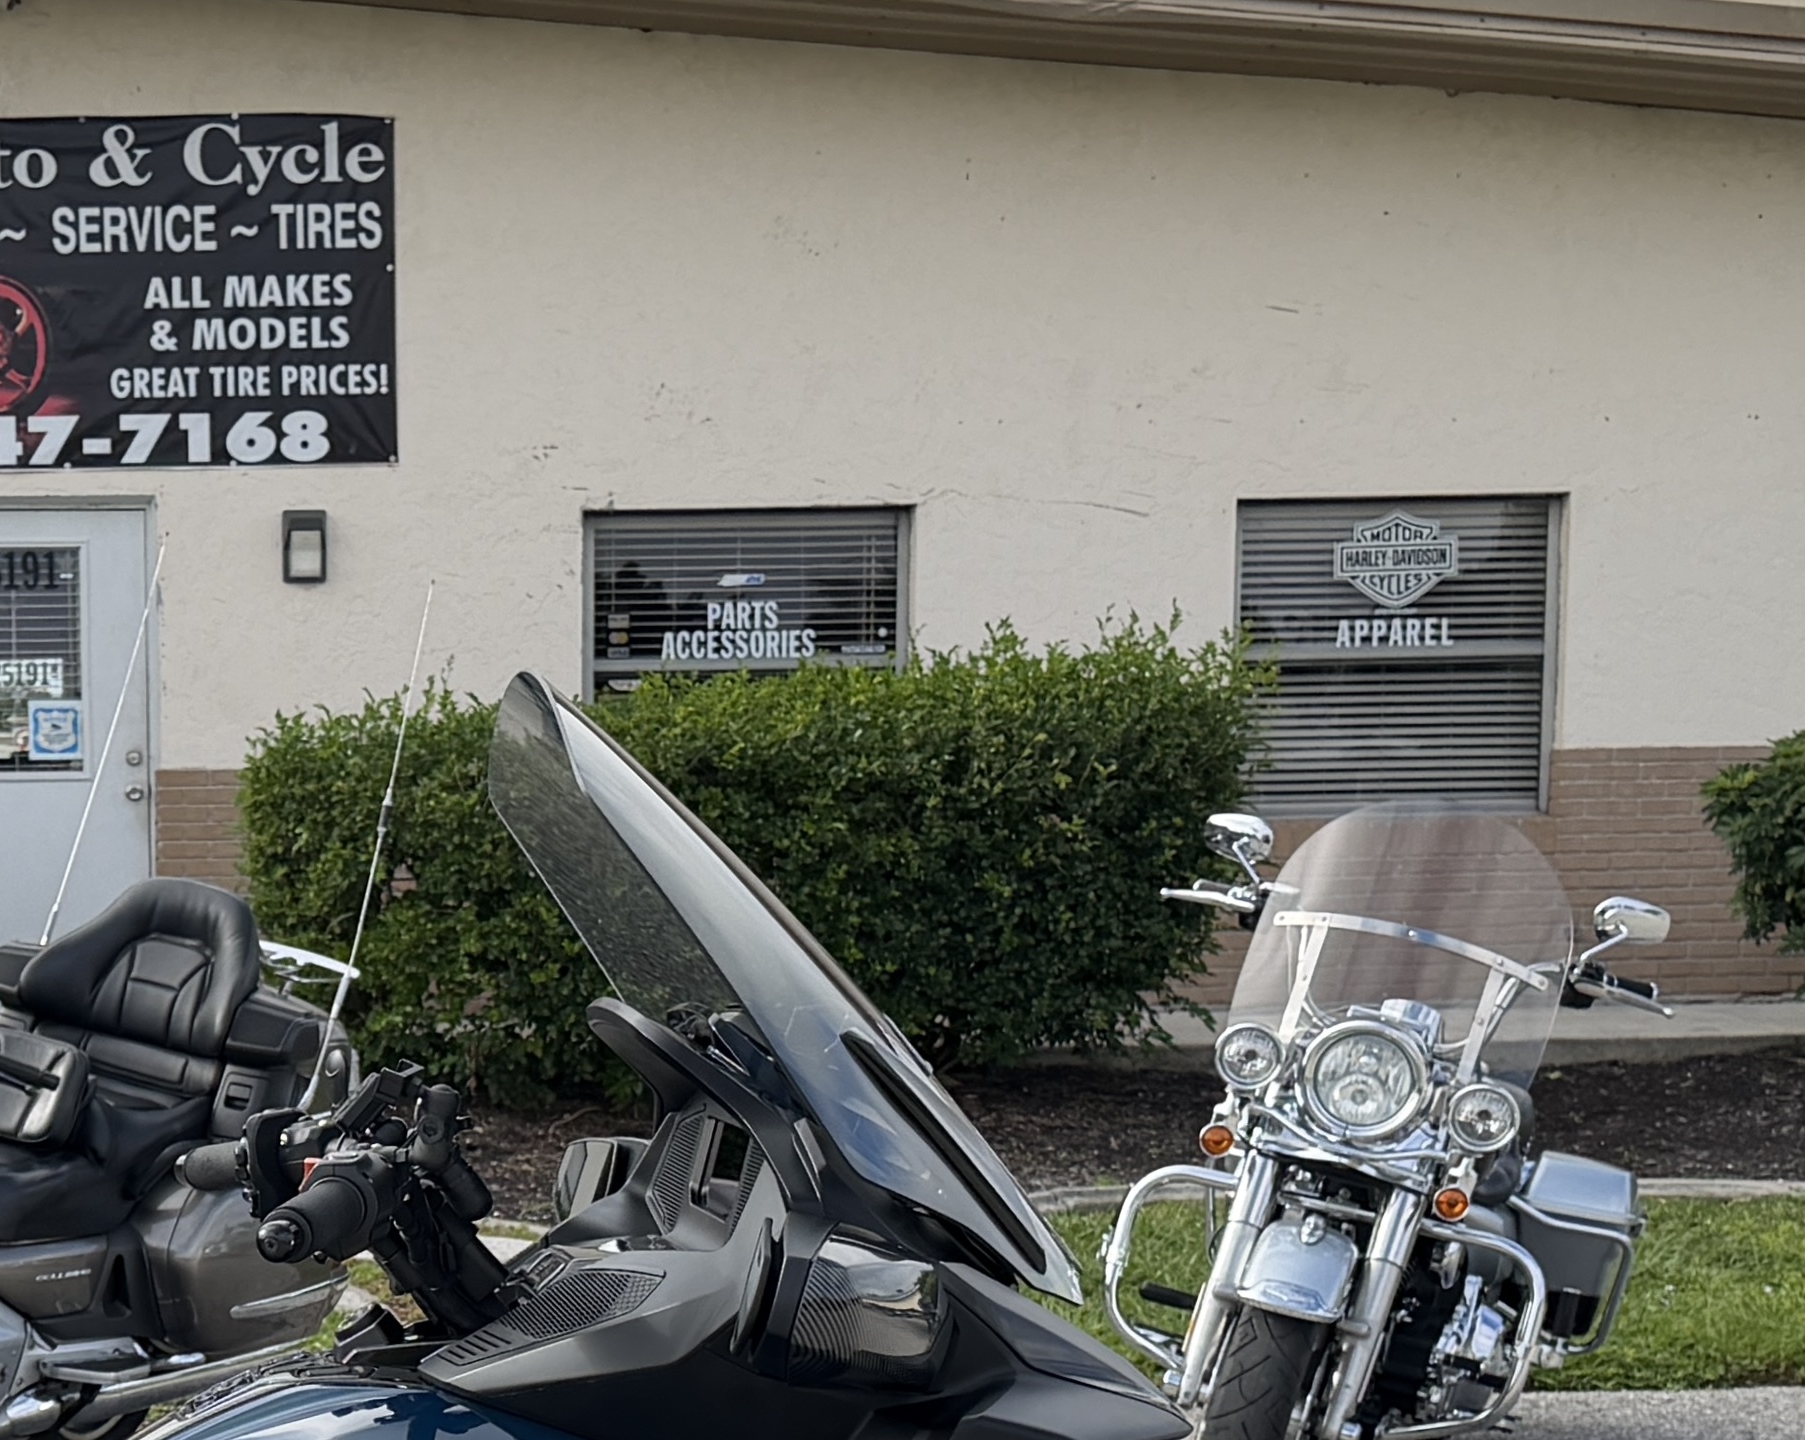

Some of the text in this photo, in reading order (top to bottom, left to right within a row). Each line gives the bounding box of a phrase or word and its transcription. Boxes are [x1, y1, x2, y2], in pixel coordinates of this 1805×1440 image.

[89, 124, 153, 187] &
[183, 121, 385, 196] Cycle
[52, 204, 218, 254] SERVICE
[270, 201, 383, 250] TIRES
[144, 273, 354, 309] ALL MAKES
[150, 316, 351, 351] & MODELS
[110, 363, 389, 399] GREAT TIRE PRICES!
[1370, 522, 1424, 542] MOTOR
[1368, 573, 1423, 596] CYCLES
[707, 600, 778, 630] PARTS
[661, 629, 816, 661] ACCESSORIES
[1335, 617, 1454, 649] APPAREL
